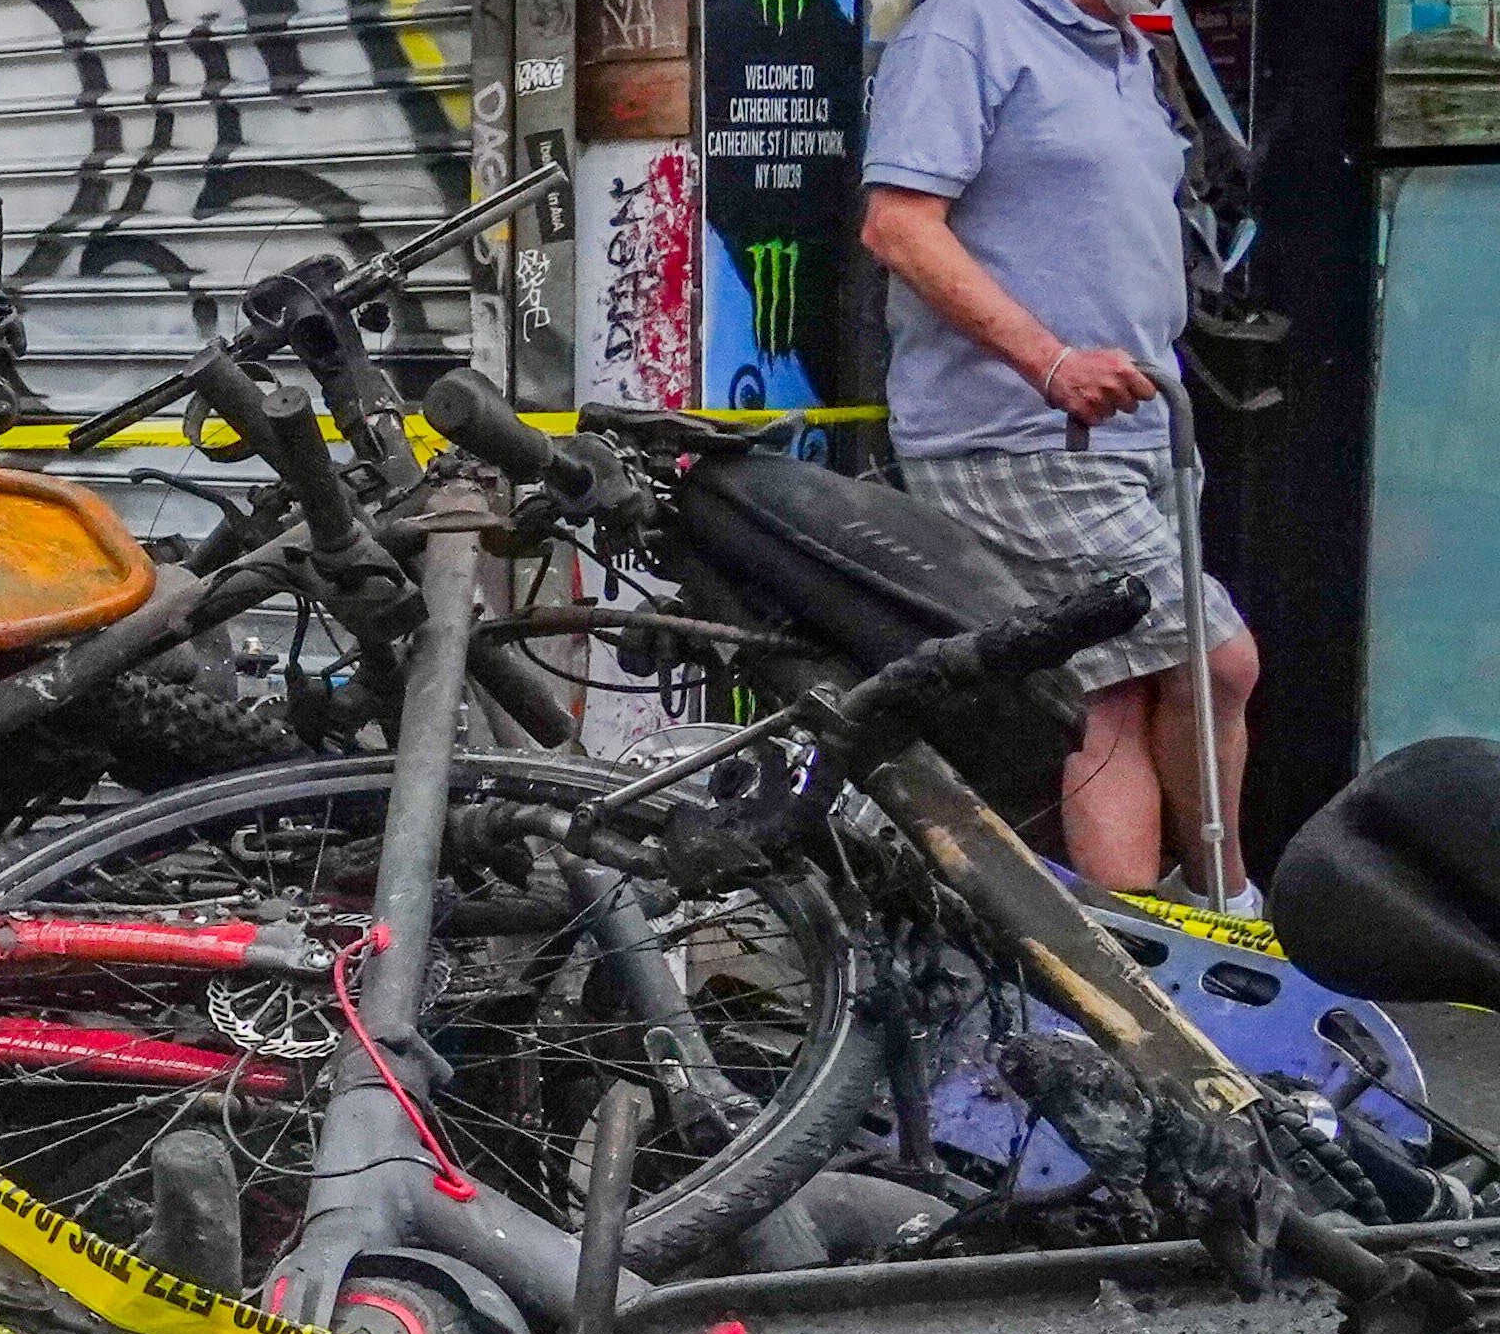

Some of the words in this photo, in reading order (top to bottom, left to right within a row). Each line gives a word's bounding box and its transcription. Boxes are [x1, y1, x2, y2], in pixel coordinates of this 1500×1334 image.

[743, 64, 798, 91] WELCOME
[799, 64, 814, 90] TO
[729, 97, 788, 124] CATHERINE
[790, 98, 815, 124] DELI
[816, 99, 829, 124] 43
[707, 130, 766, 157] CATHERINE
[767, 131, 782, 156] ST
[789, 131, 812, 156] NEW
[754, 164, 768, 189] NY
